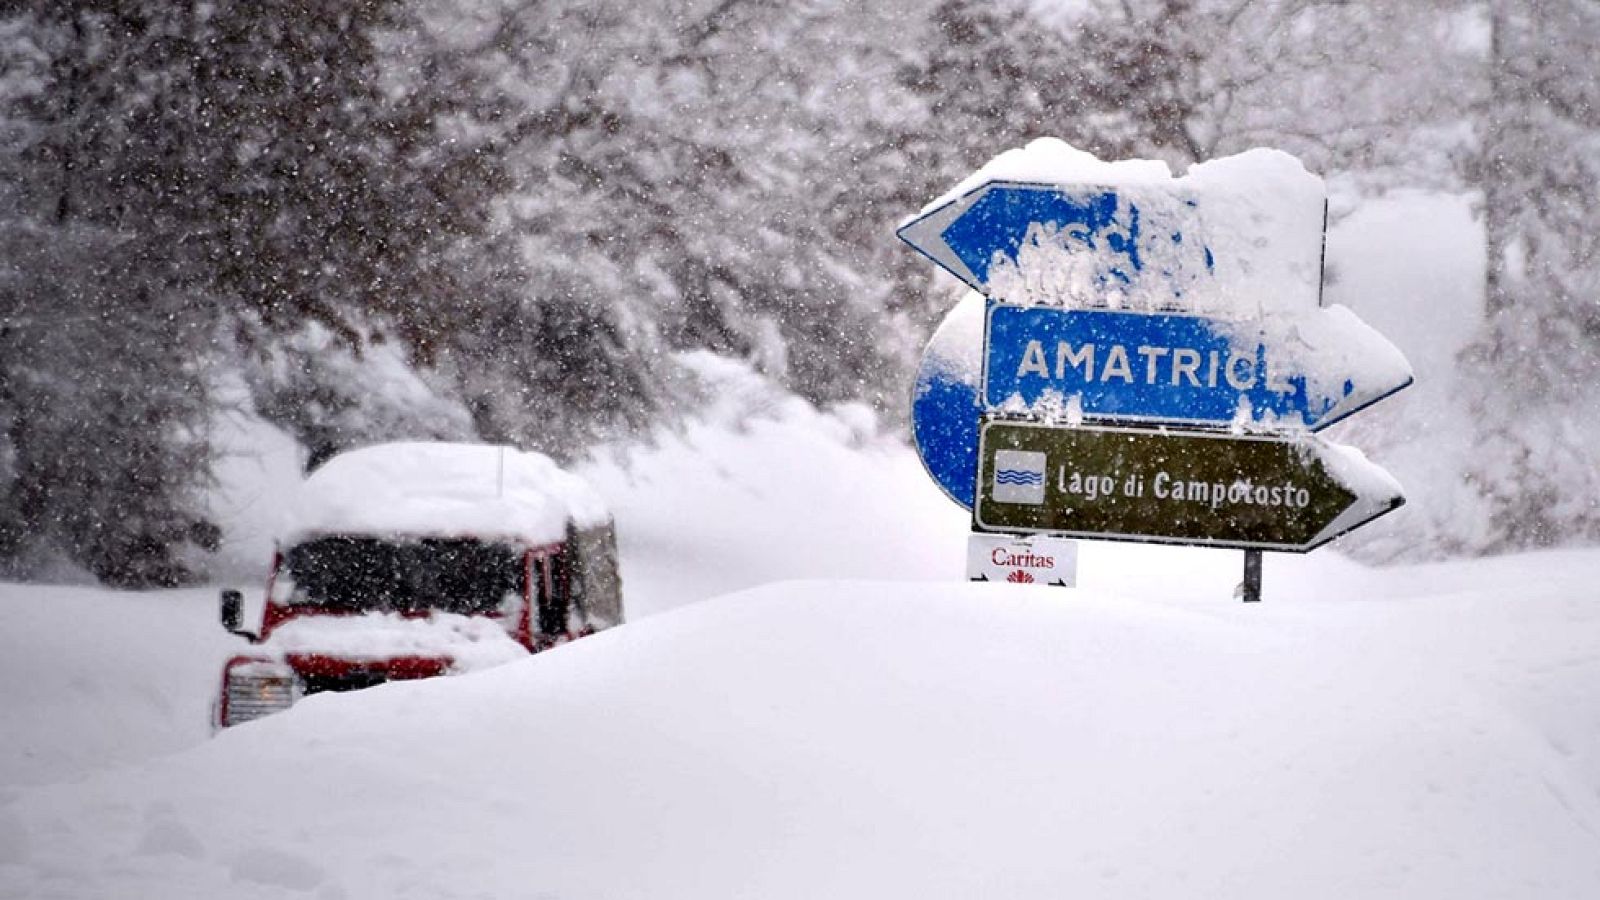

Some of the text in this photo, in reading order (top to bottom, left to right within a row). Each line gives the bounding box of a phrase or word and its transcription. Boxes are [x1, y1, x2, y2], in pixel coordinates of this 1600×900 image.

[1124, 473, 1144, 498] di
[1153, 471, 1310, 509] Campotosto
[991, 547, 1055, 569] Caritas
